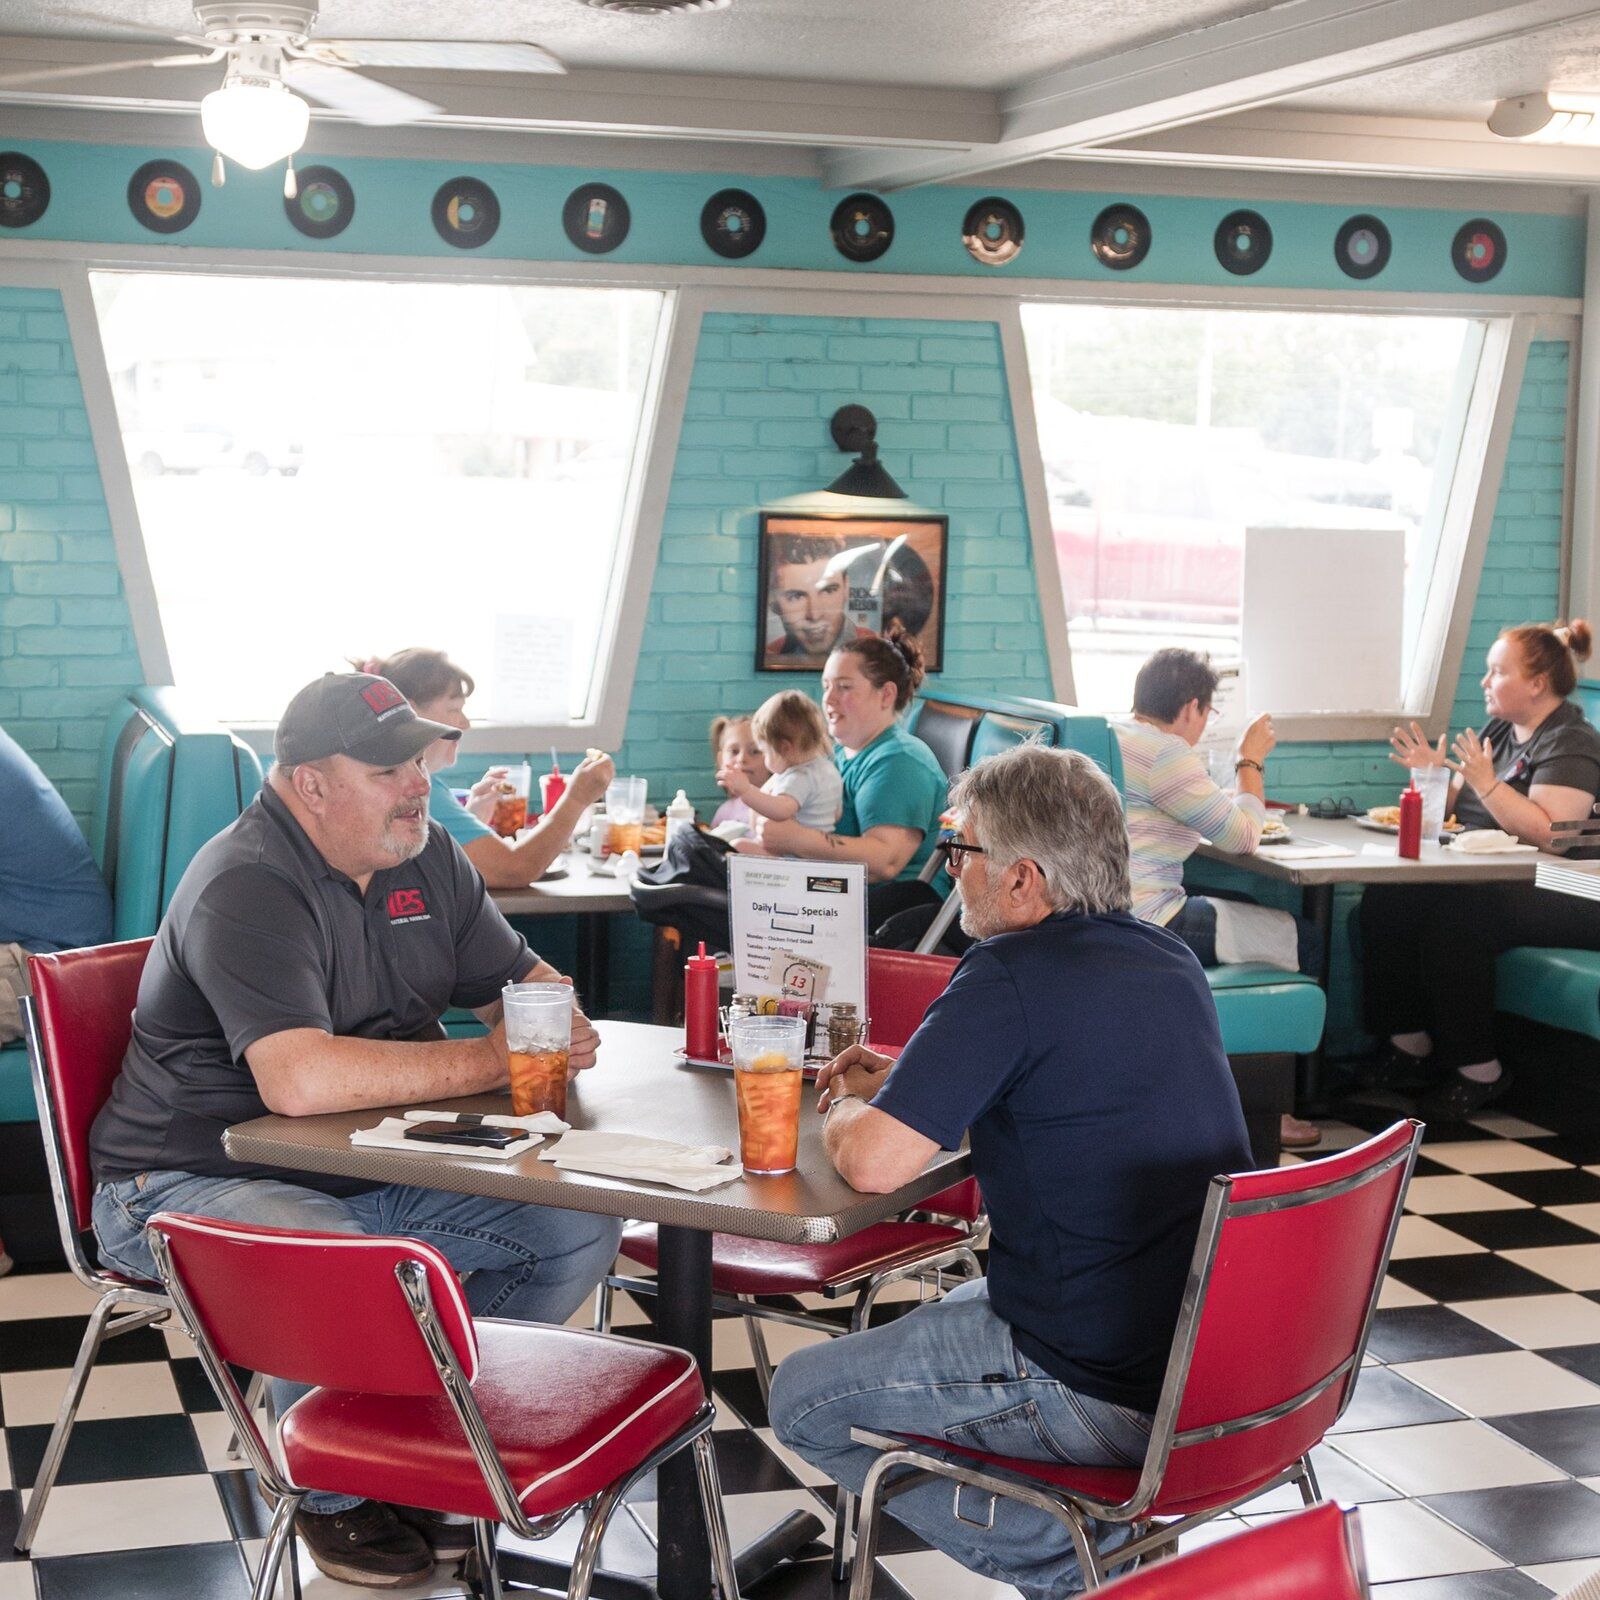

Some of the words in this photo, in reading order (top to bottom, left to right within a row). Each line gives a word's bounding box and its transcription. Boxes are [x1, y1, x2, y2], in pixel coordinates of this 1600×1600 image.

[849, 587, 876, 598] RICK
[849, 599, 878, 611] NELSON
[752, 902, 772, 914] Daily
[801, 906, 838, 917] Specials
[790, 975, 807, 989] 13
